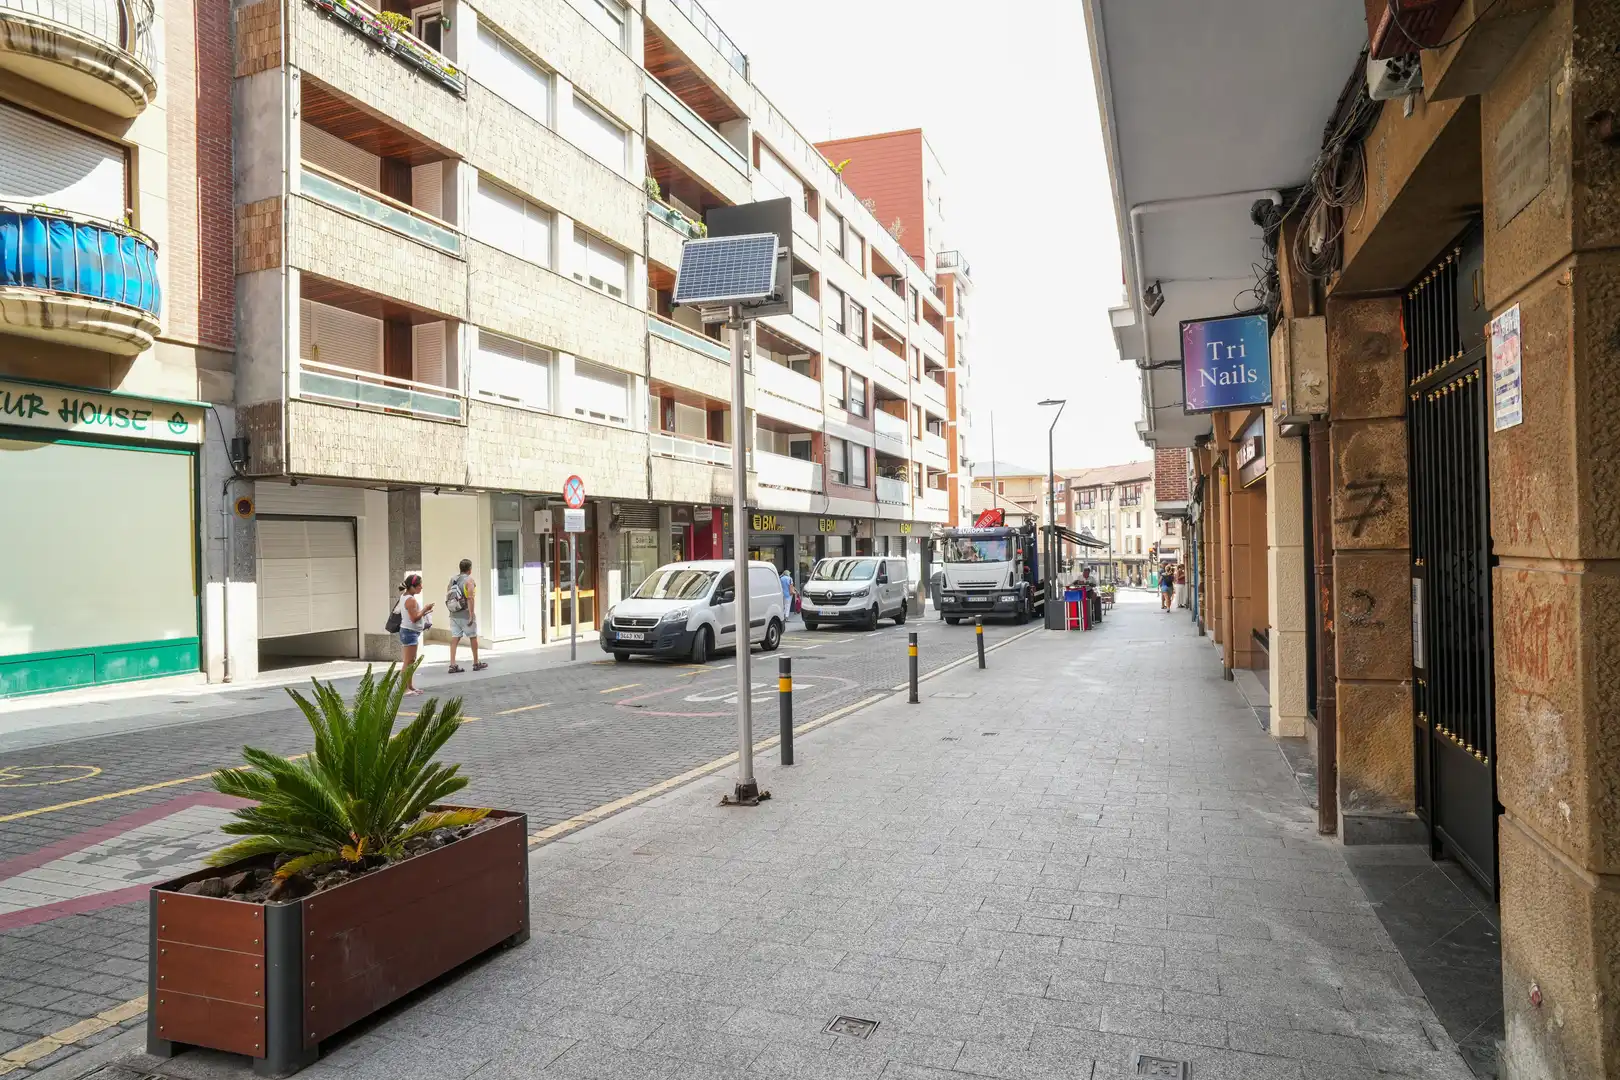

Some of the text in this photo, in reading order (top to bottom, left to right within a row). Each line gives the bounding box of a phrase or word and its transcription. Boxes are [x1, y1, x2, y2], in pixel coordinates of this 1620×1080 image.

[1207, 338, 1247, 361] Tri
[1197, 364, 1258, 388] Nails
[0, 391, 151, 431] UR HOUSE
